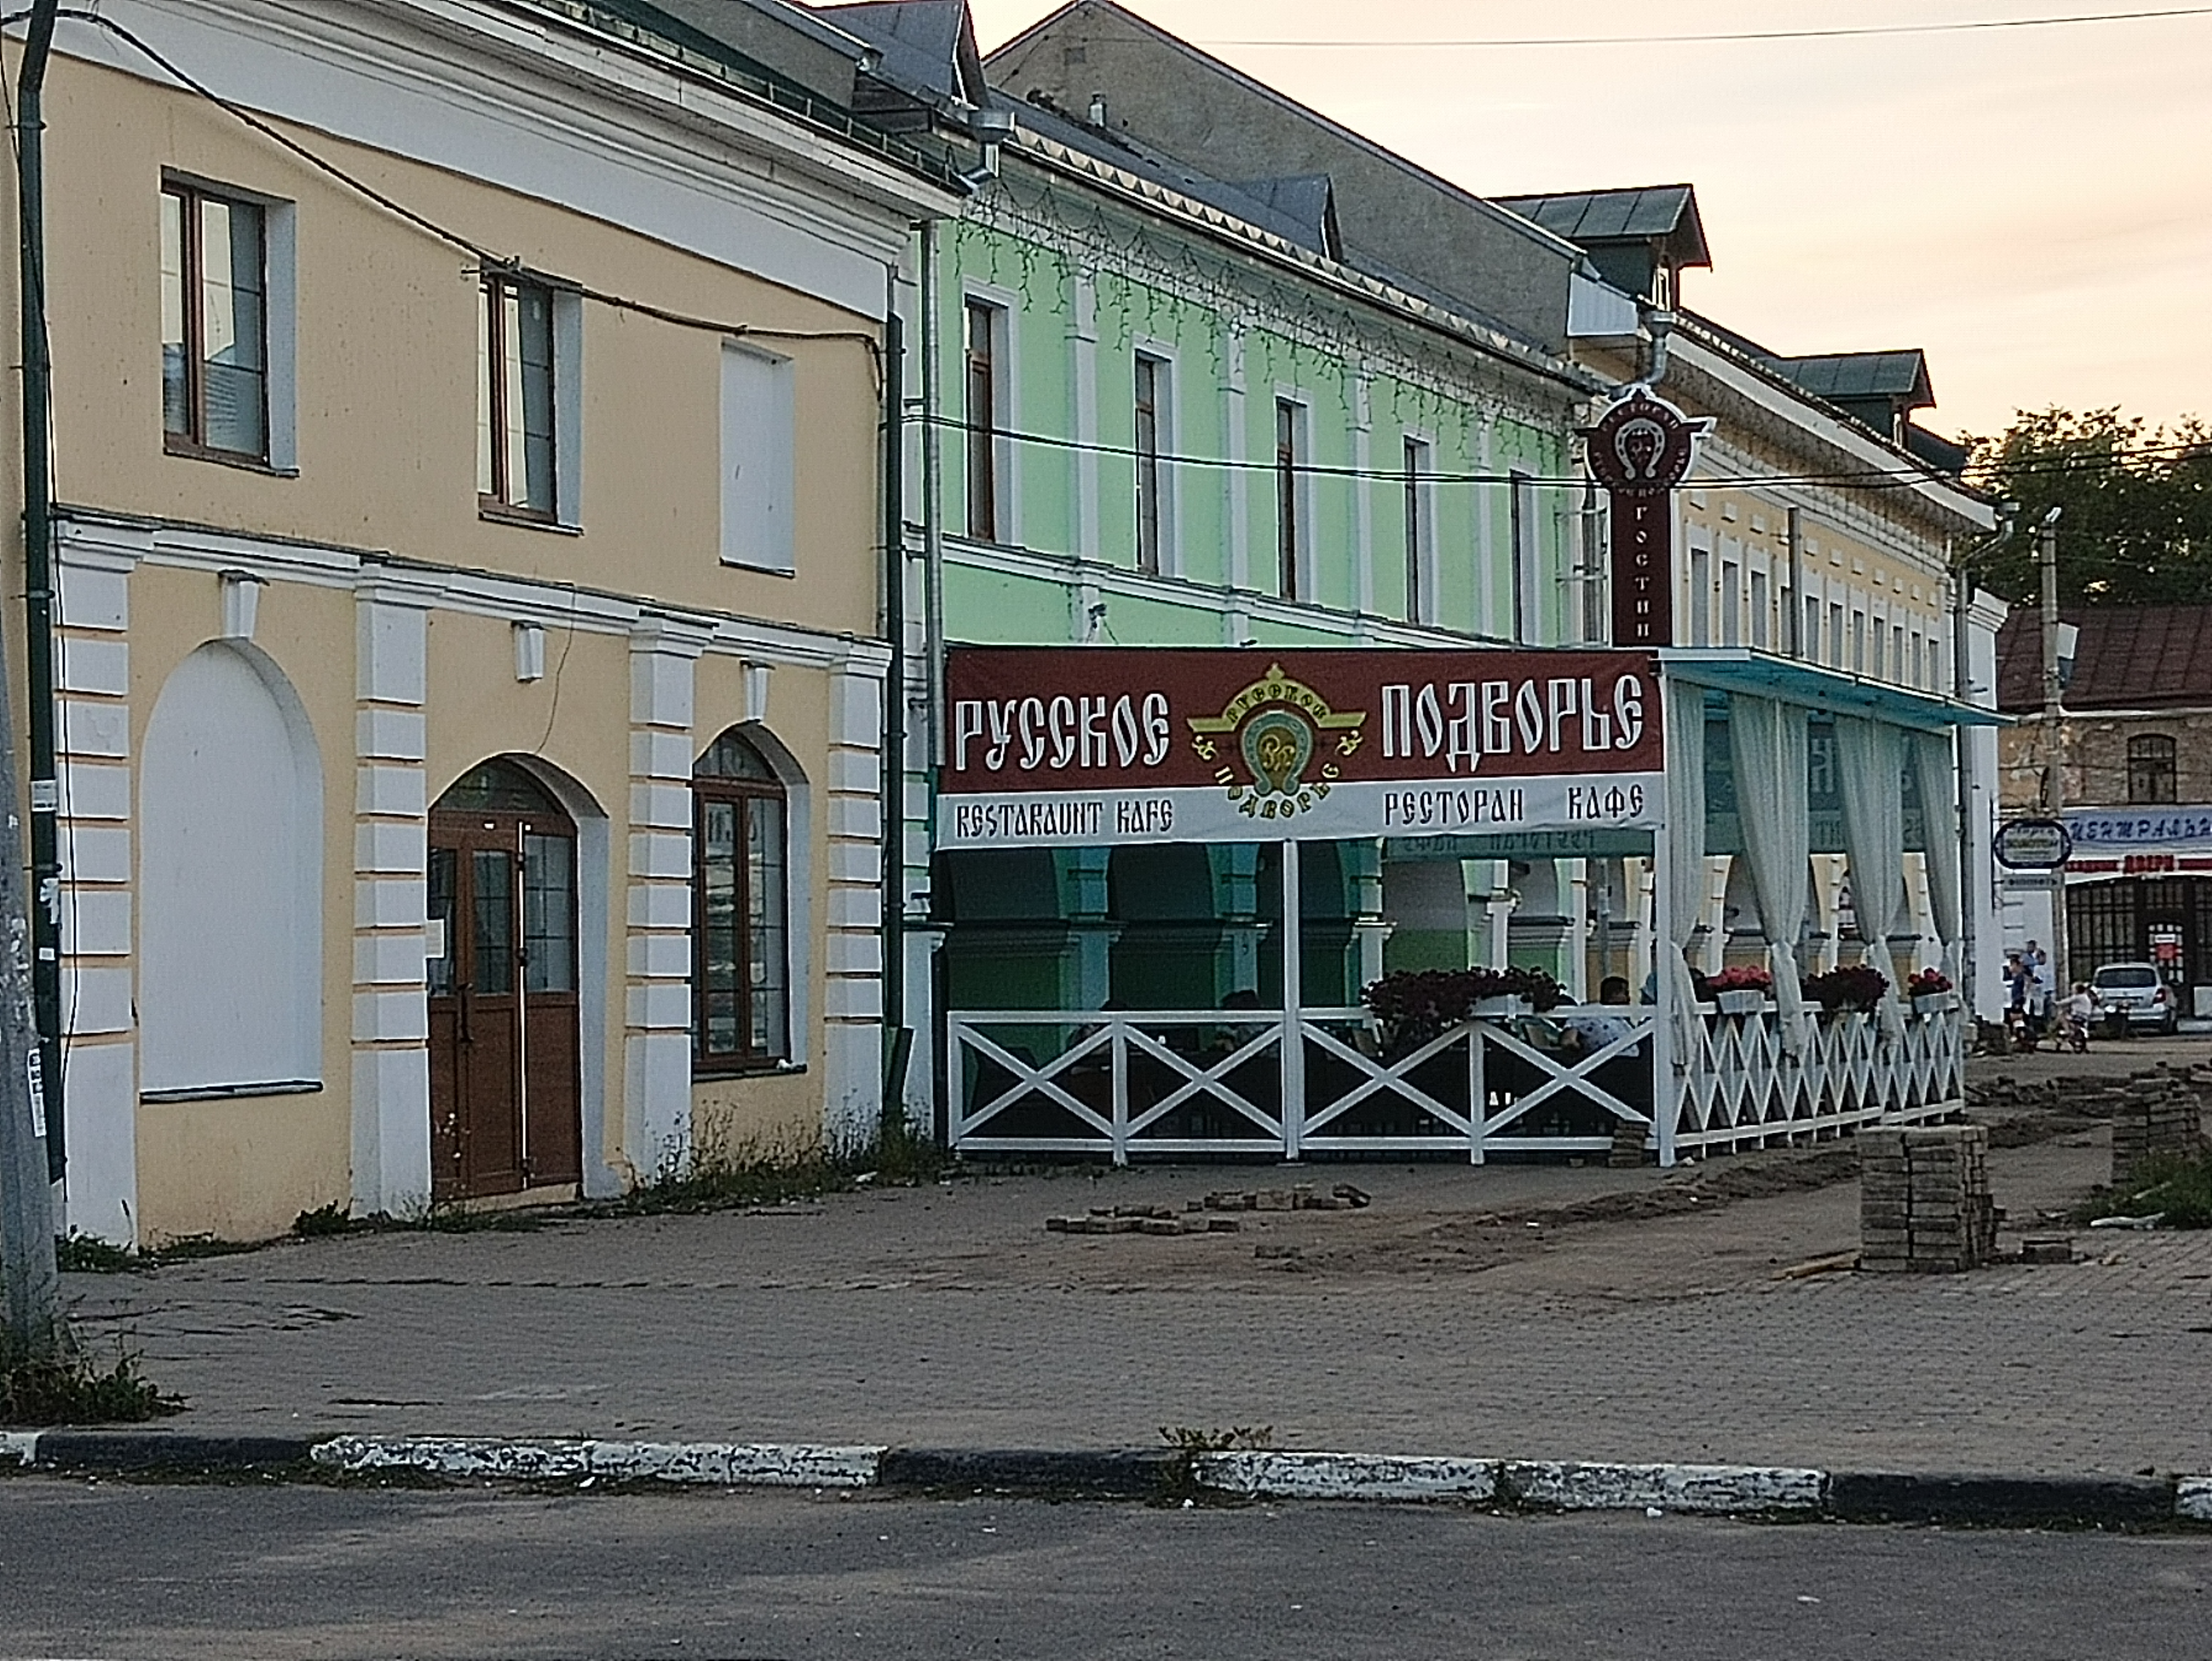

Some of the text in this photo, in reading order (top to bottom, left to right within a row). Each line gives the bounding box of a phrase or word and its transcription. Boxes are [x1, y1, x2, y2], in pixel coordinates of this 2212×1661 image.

[956, 675, 1643, 773] РУССКОЕ ПОДВОРЬЕ
[1226, 684, 1328, 724] РУССКОЕ
[1215, 763, 1340, 819] ПОДВОРЬЕ
[1384, 785, 1644, 826] РЕСТОРАН КАФЕ
[957, 798, 1173, 838] RESTARAUNT KAFE
